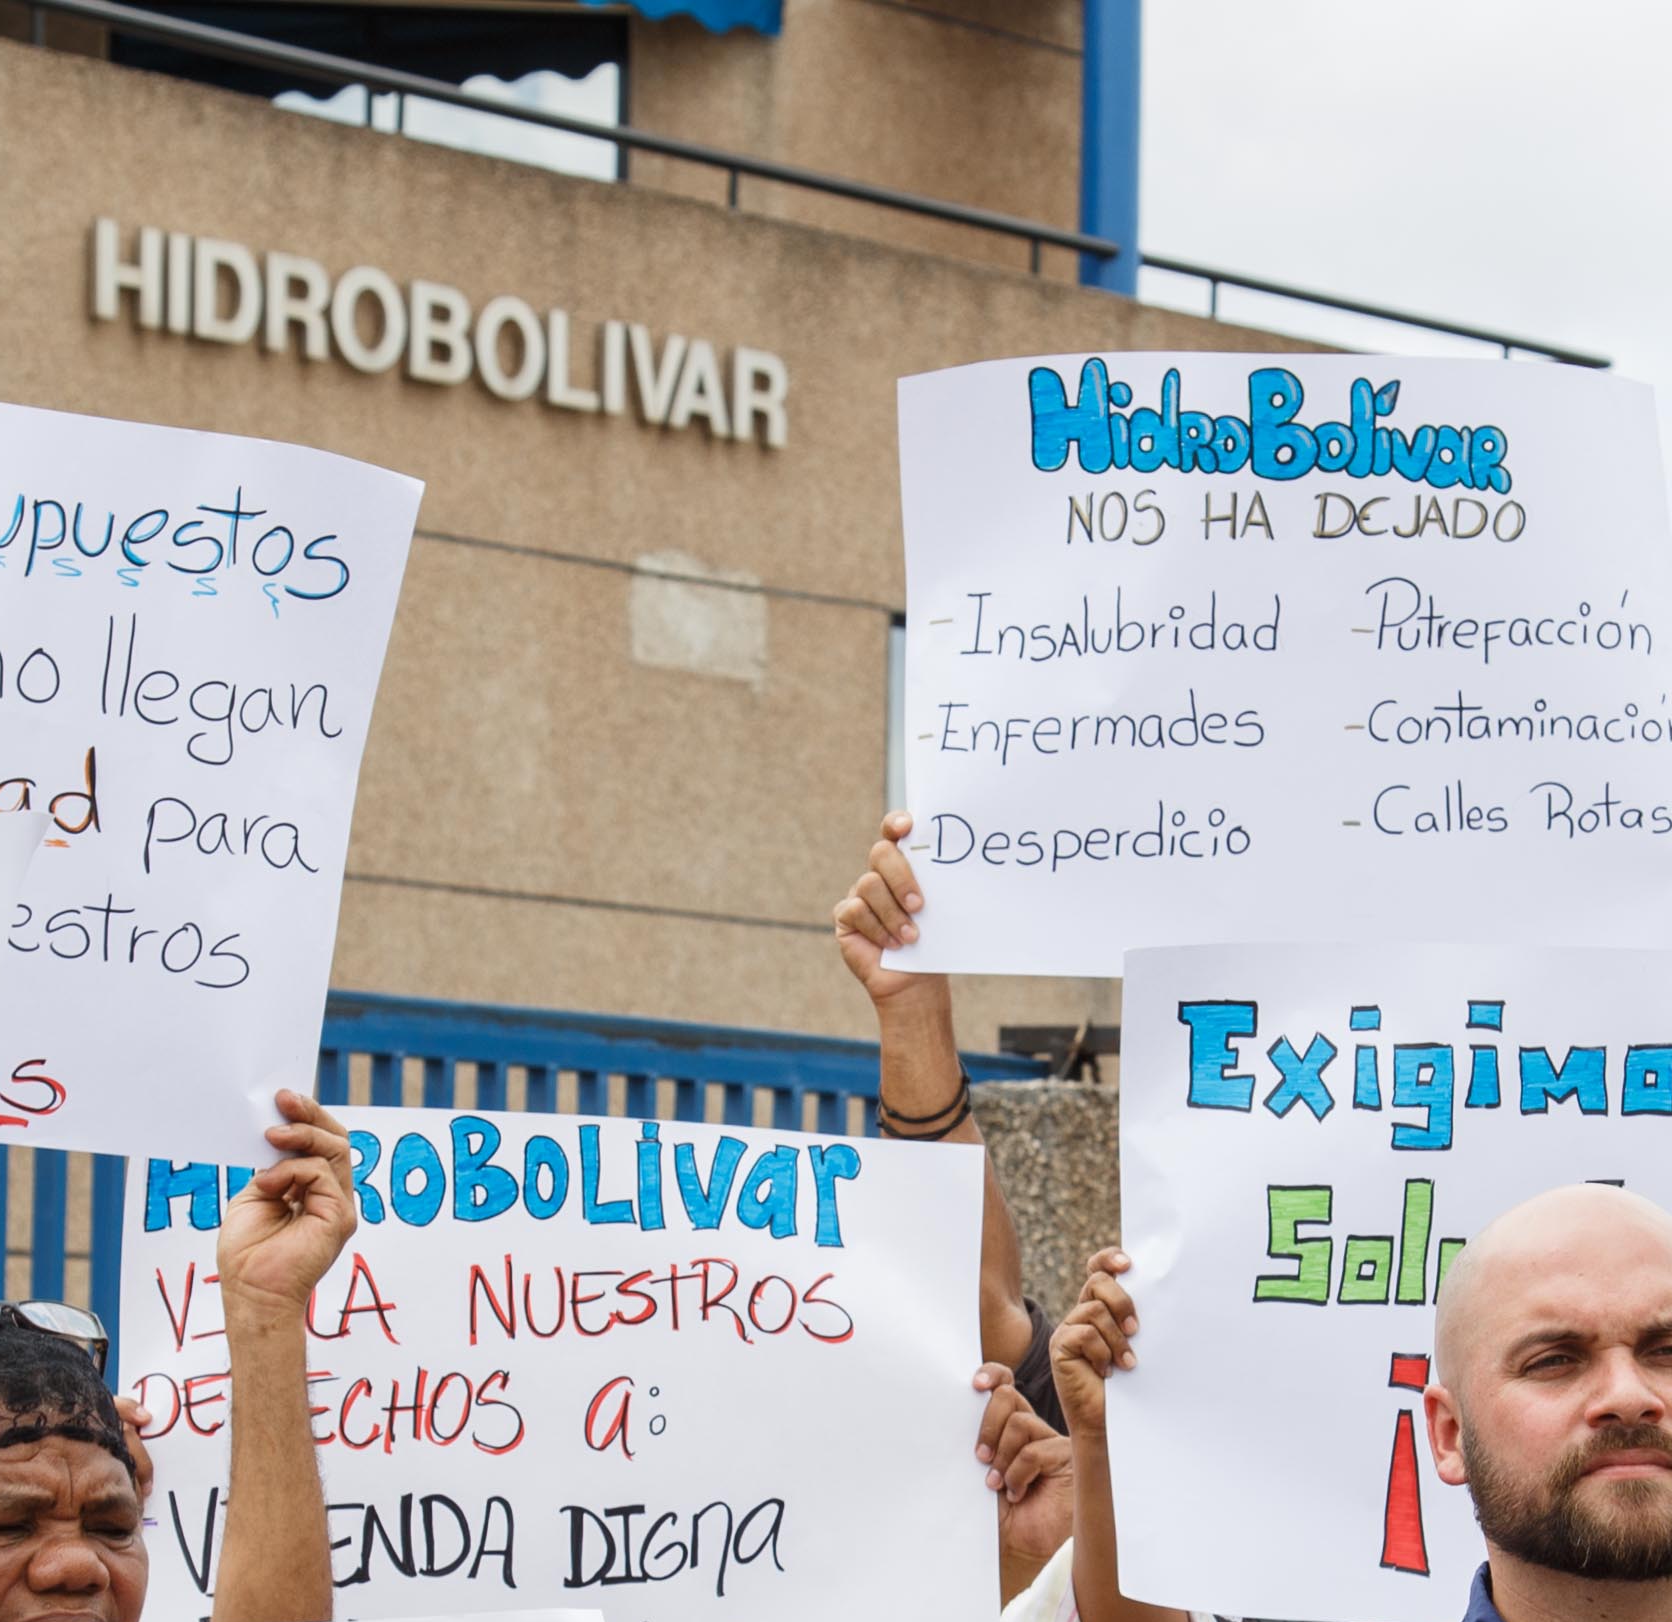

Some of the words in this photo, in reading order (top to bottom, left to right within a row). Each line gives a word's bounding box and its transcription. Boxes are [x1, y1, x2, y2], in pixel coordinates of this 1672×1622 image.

[92, 215, 788, 449] HIDROBOLIVAR
[1067, 489, 1166, 546] NOS
[1200, 490, 1275, 541] HA
[1312, 490, 1527, 544] DEJADO
[102, 613, 343, 766] llegan
[143, 797, 319, 874] para
[1530, 781, 1672, 839] Rotas
[469, 1254, 854, 1346] NUESTROS
